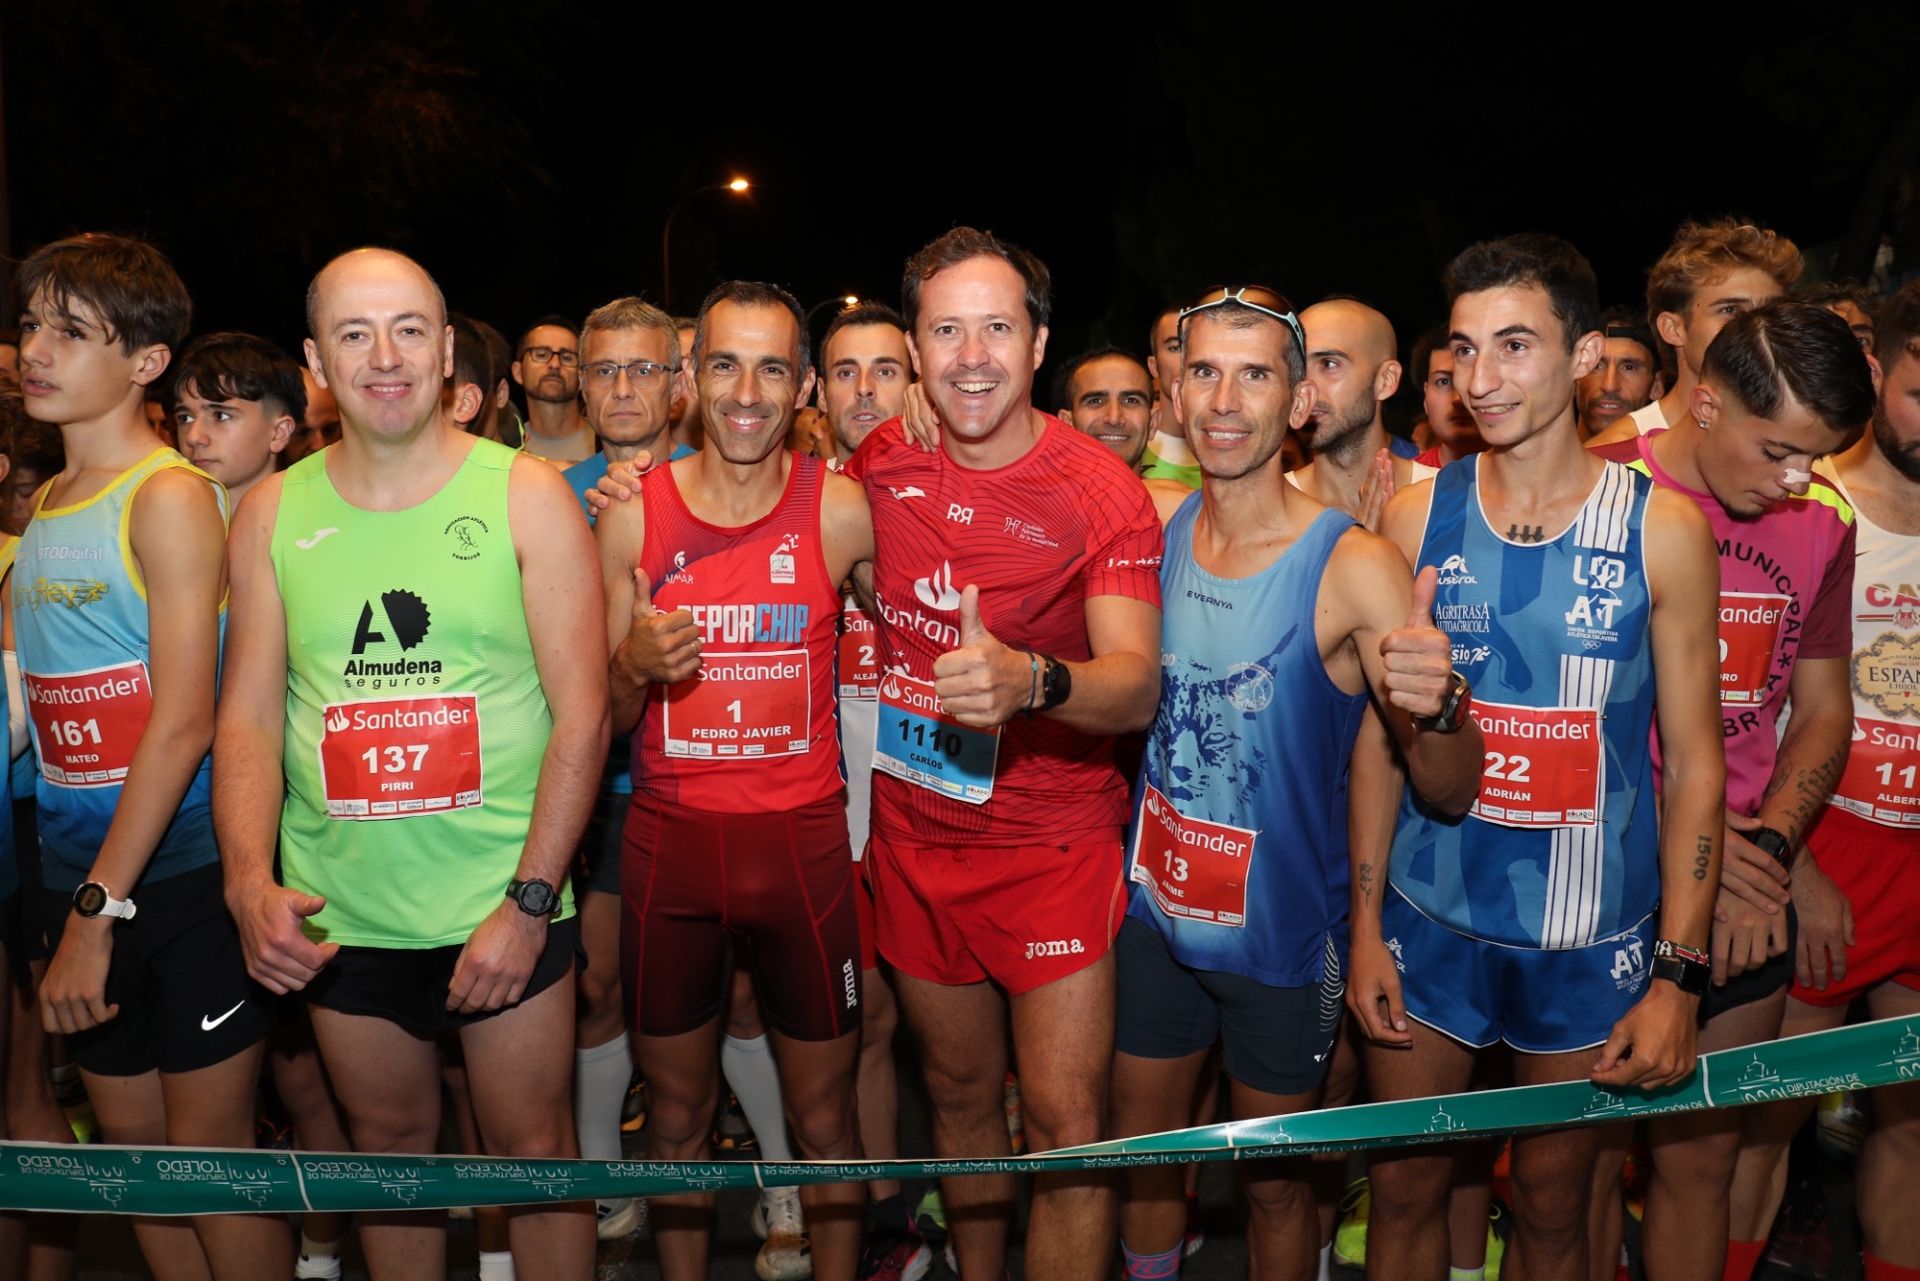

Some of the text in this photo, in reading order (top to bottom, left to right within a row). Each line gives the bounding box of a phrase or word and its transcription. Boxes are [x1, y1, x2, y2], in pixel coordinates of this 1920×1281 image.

[1865, 583, 1920, 608] CA
[1435, 601, 1490, 620] AGRITRASA
[677, 602, 809, 644] EPORCHIP
[344, 658, 442, 676] Almudena
[697, 661, 803, 682] Santander
[344, 676, 441, 690] seguros
[1719, 673, 1738, 682] RO
[36, 677, 140, 705] Santander
[352, 705, 471, 731] Santander
[726, 700, 742, 724] 1
[50, 718, 103, 746] 161
[692, 725, 791, 739] PEDRO JAVIER
[898, 718, 962, 757] 1110
[65, 753, 100, 764] MATEO
[362, 744, 430, 774] 137
[910, 752, 943, 770] CARLOS
[1483, 751, 1531, 783] 22
[381, 781, 414, 792] PIRRI
[1484, 786, 1532, 801] ADRIÁN
[1160, 806, 1247, 858] Santander
[1164, 848, 1189, 882] 13
[1786, 1072, 1860, 1093] DIPUTACIÓN DE
[1690, 1100, 1705, 1109] DE
[17, 1155, 84, 1169] TOLEDO
[157, 1160, 225, 1173] TOLEDO
[303, 1162, 374, 1172] TOLEDO
[453, 1163, 524, 1172] TOLEDO
[159, 1172, 227, 1182] DIPUTACIÓN DE
[307, 1171, 377, 1181] DIPUTACIÓN DE
